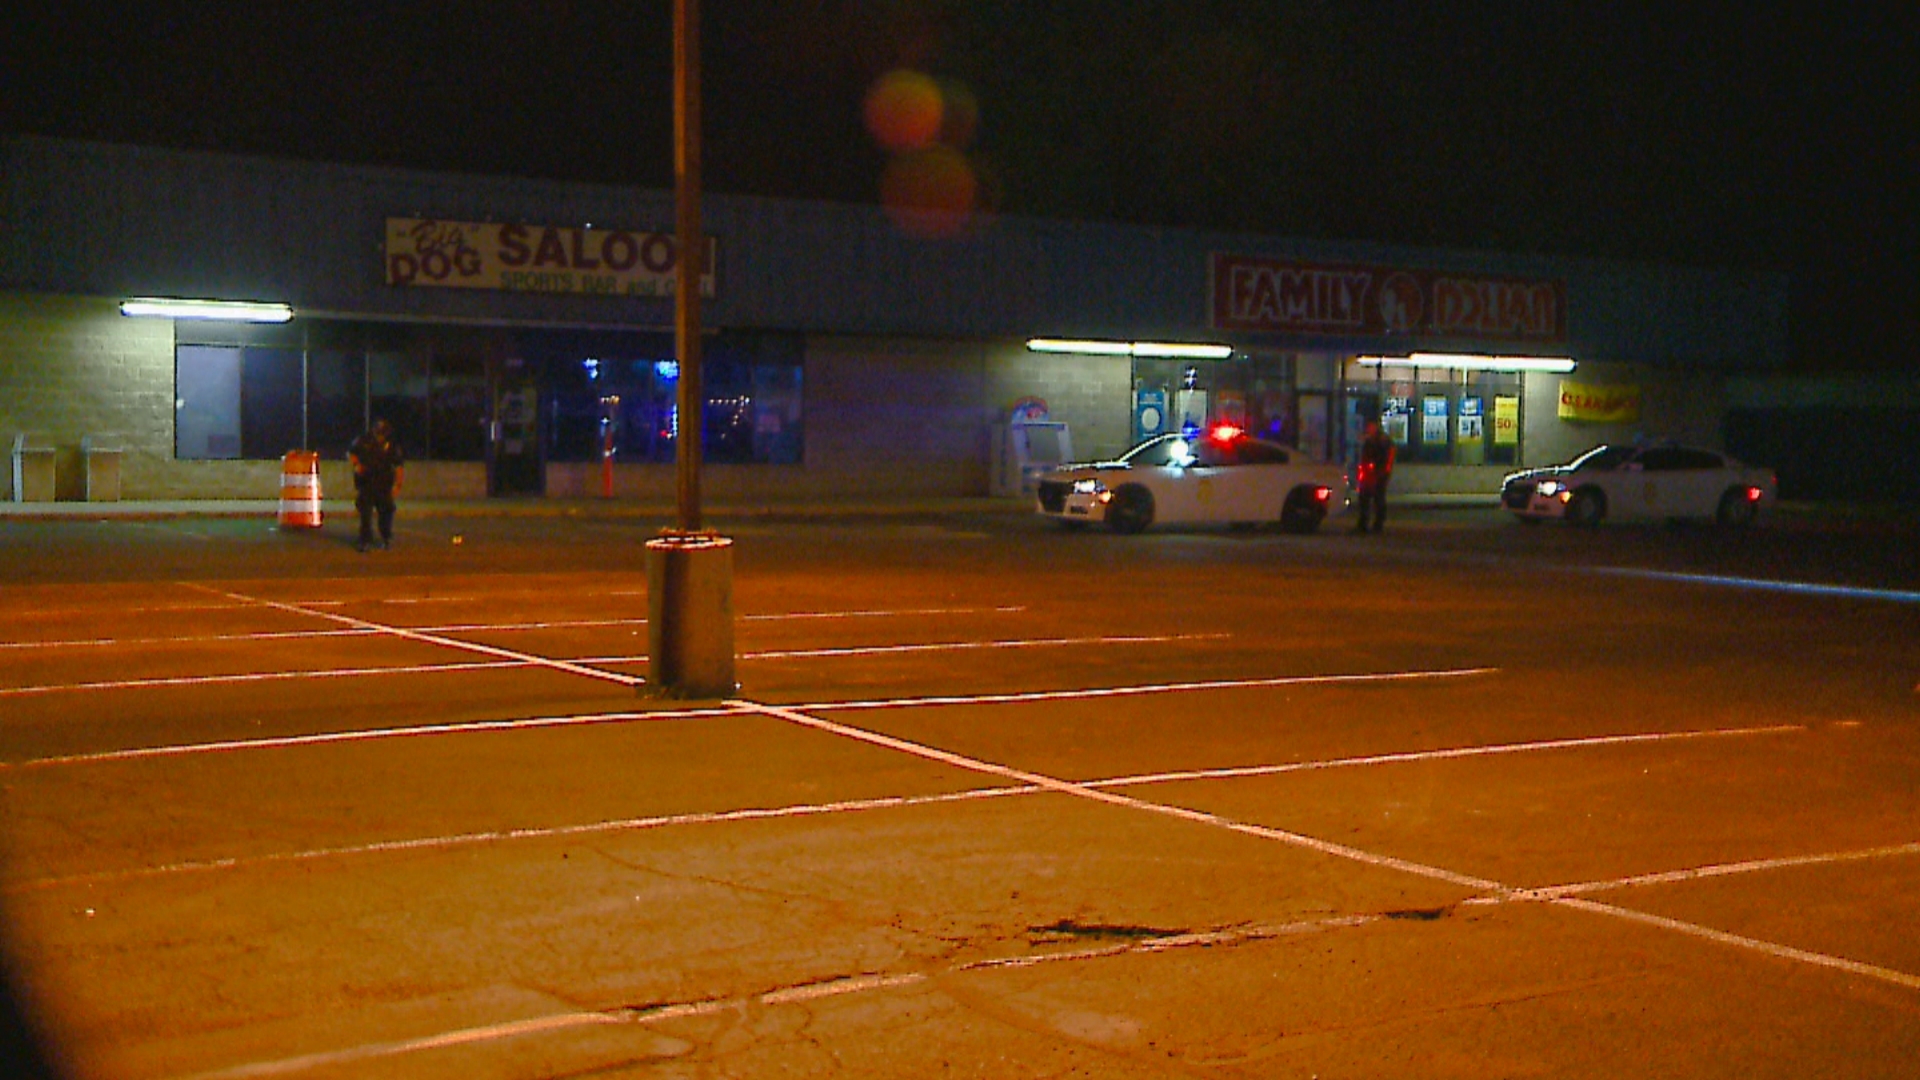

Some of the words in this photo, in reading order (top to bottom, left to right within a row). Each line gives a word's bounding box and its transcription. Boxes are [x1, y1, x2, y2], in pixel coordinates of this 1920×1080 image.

[389, 244, 481, 287] DOG
[501, 270, 574, 292] SPORTS
[583, 274, 616, 294] BAR
[628, 279, 657, 296] and
[1229, 265, 1373, 325] FAMILY
